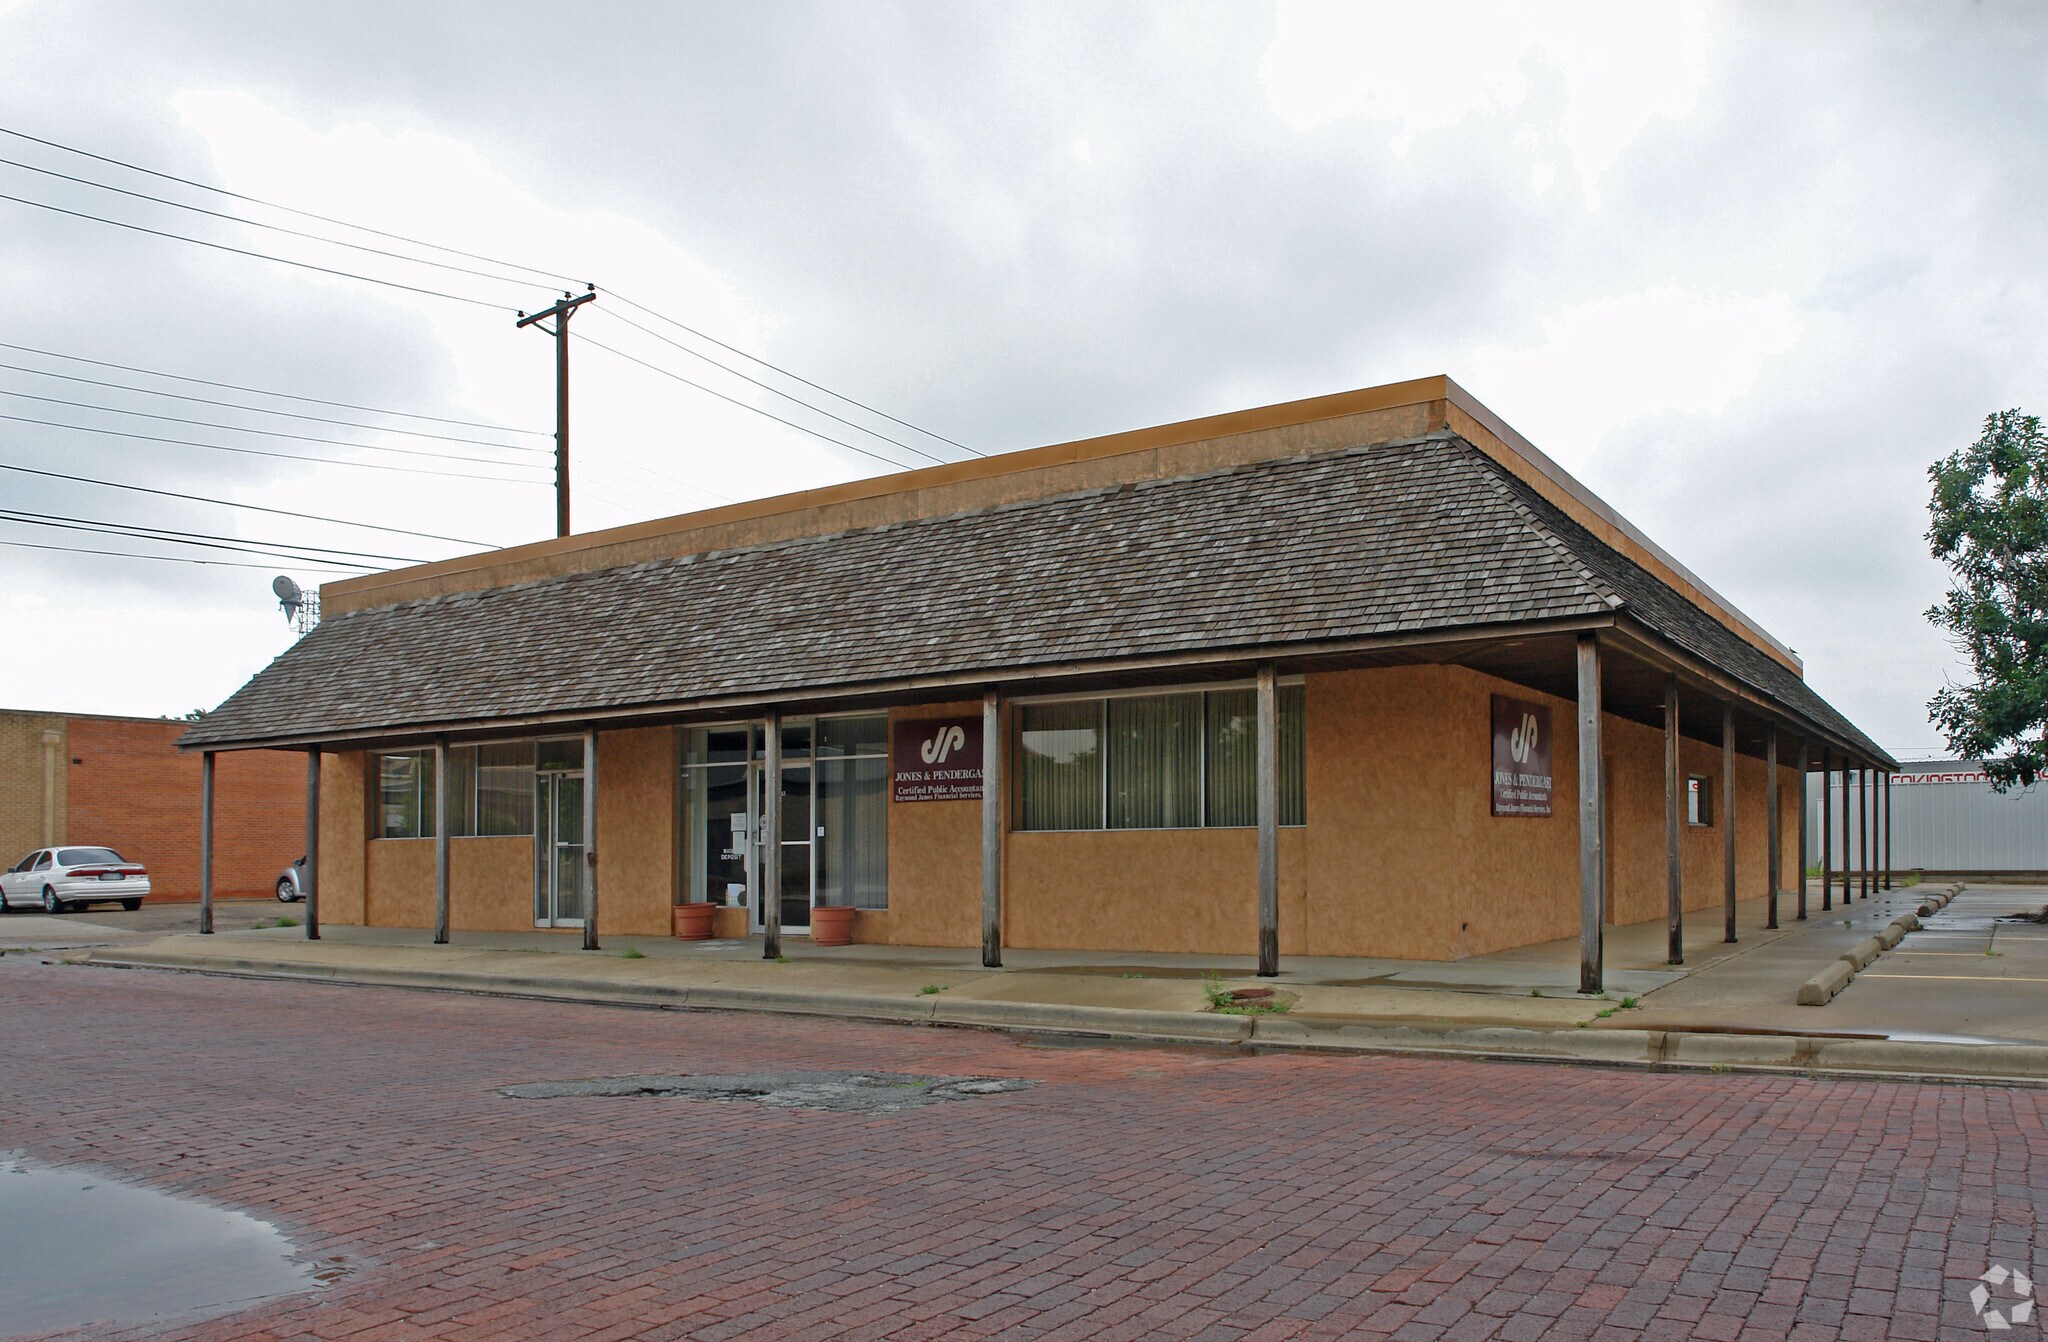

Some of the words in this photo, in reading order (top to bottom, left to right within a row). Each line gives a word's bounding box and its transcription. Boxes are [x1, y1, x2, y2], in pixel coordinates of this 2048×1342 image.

[895, 771, 922, 781] JONES
[924, 771, 931, 780] &
[933, 769, 983, 780] PENDERGA
[1494, 771, 1512, 785] JONES
[1513, 773, 1518, 786] &
[1519, 773, 1552, 789] PENDERGAST
[898, 785, 926, 795] Certified
[928, 785, 947, 793] Public
[949, 784, 983, 793] Accountan
